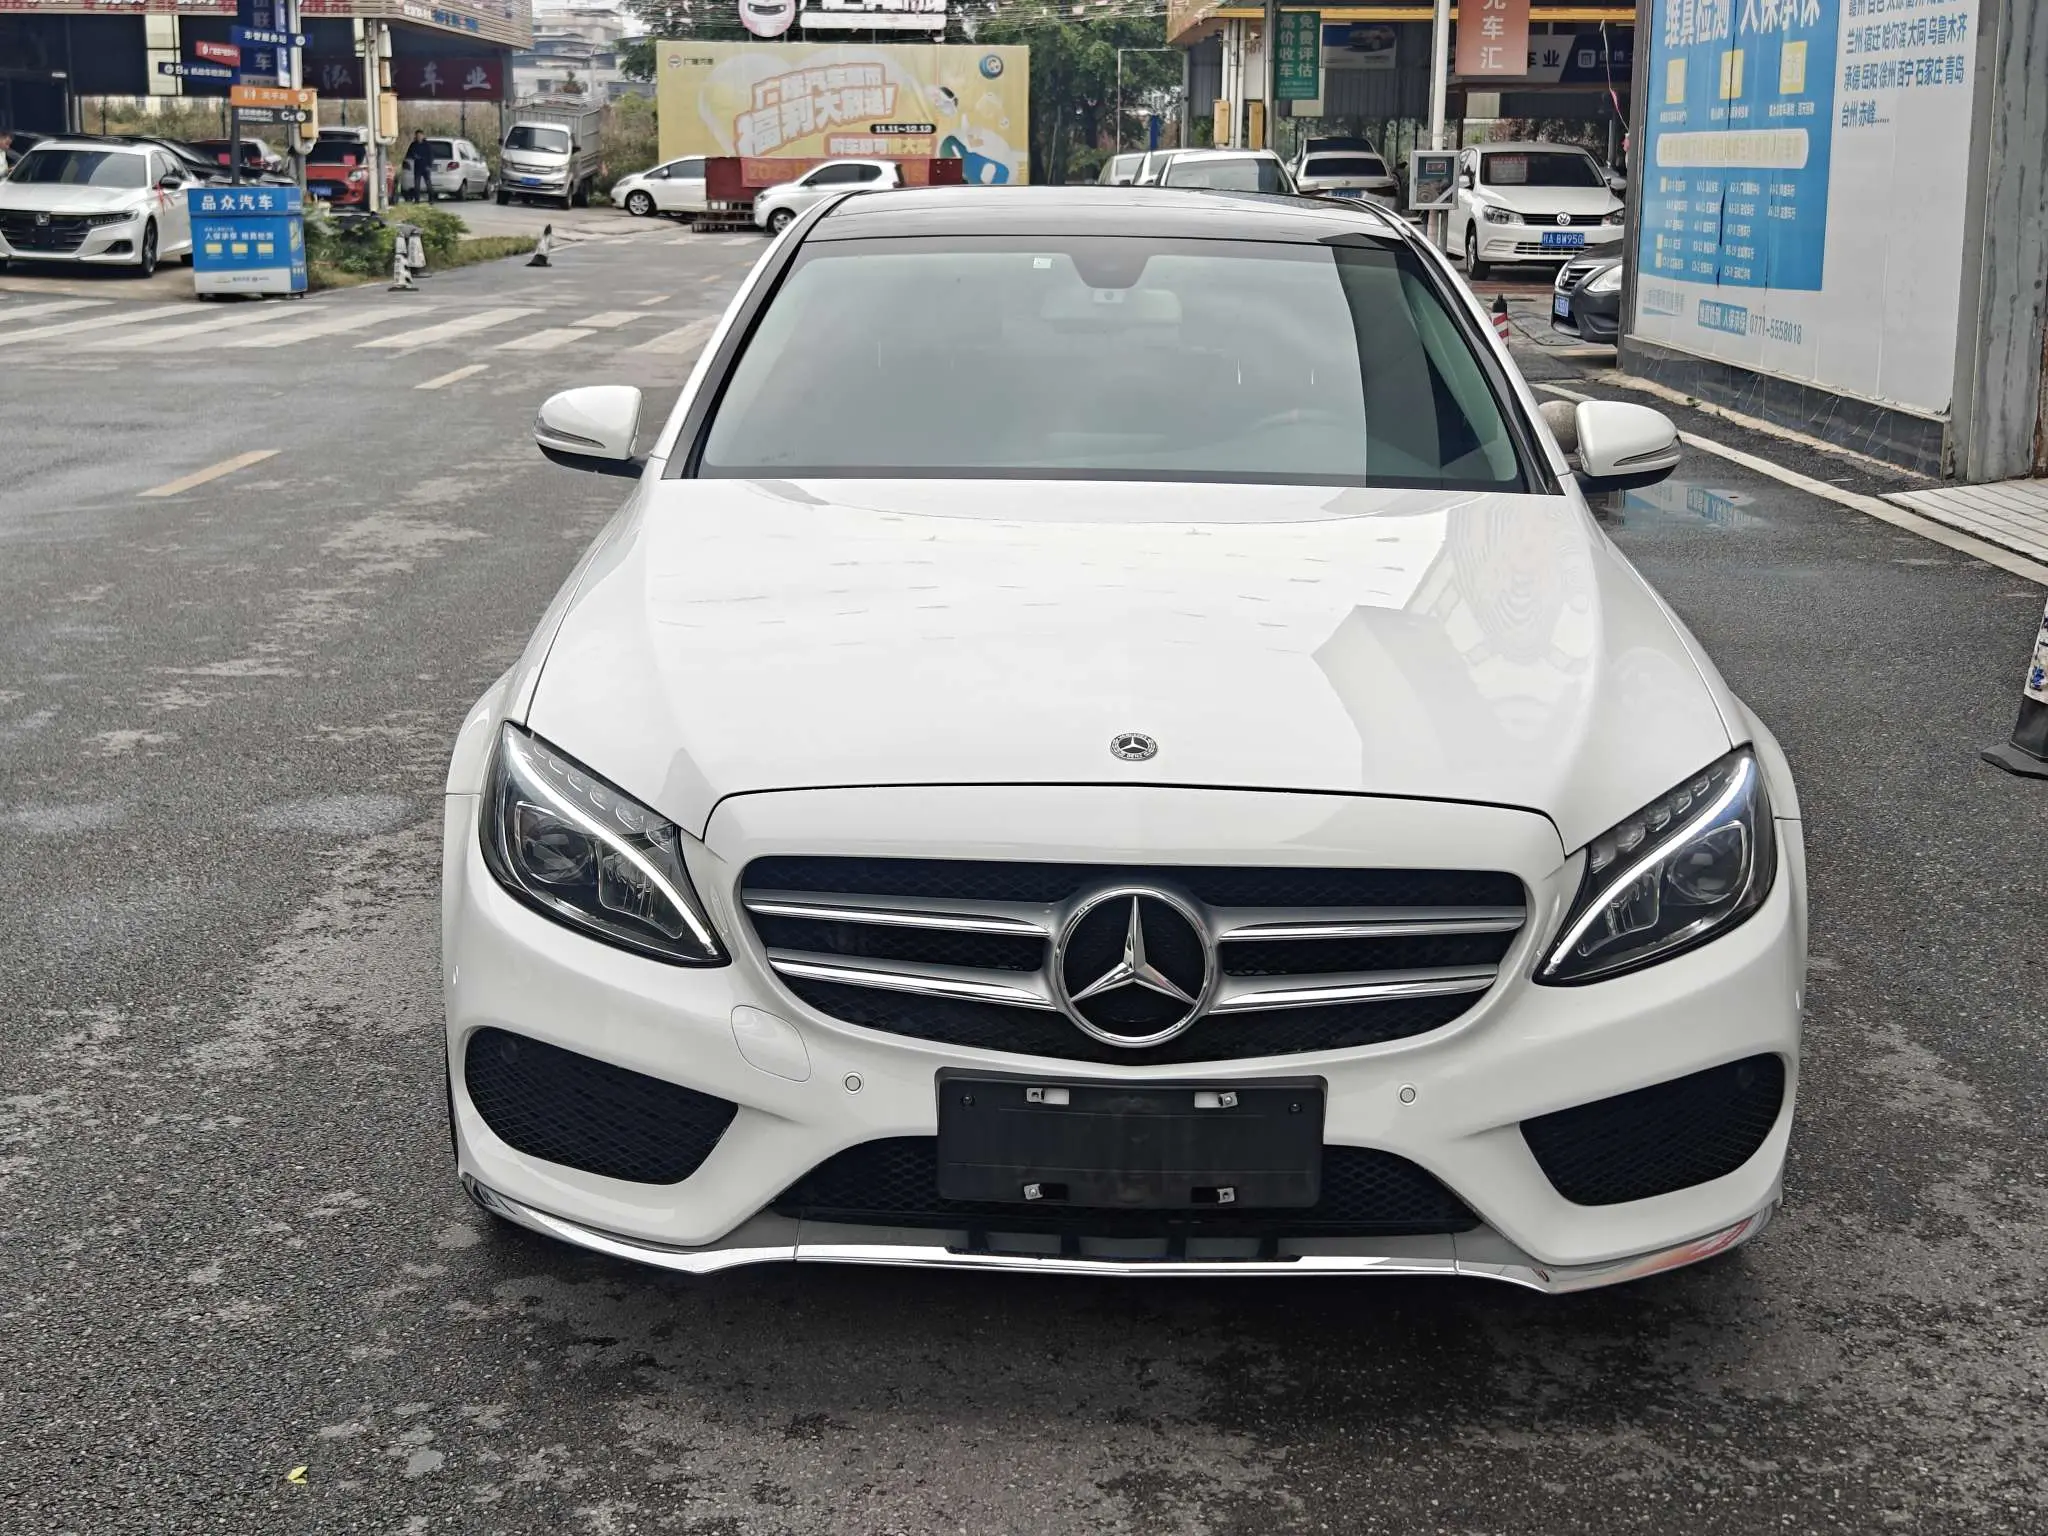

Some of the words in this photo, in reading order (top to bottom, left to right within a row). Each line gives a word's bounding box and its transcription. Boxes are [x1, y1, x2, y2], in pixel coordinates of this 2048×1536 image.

[1280, 14, 1295, 78] 高价收车
[1298, 14, 1315, 78] 免费评估
[1846, 25, 1863, 55] 兰州
[1863, 22, 1881, 52] 宿迁
[1882, 19, 1907, 51] 哈尔滨
[1907, 17, 1927, 48] 大同
[1927, 12, 1968, 46] 乌鲁木齐
[1844, 63, 1861, 92] 承德
[1861, 61, 1879, 90] 岳阳
[1879, 60, 1897, 89] 徐州
[1915, 55, 1945, 87] 石家庄
[1944, 54, 1965, 85] 青岛
[1841, 100, 1859, 129] 台州
[201, 194, 274, 211] 品众汽车
[1750, 313, 1802, 345] 0771-5558018
